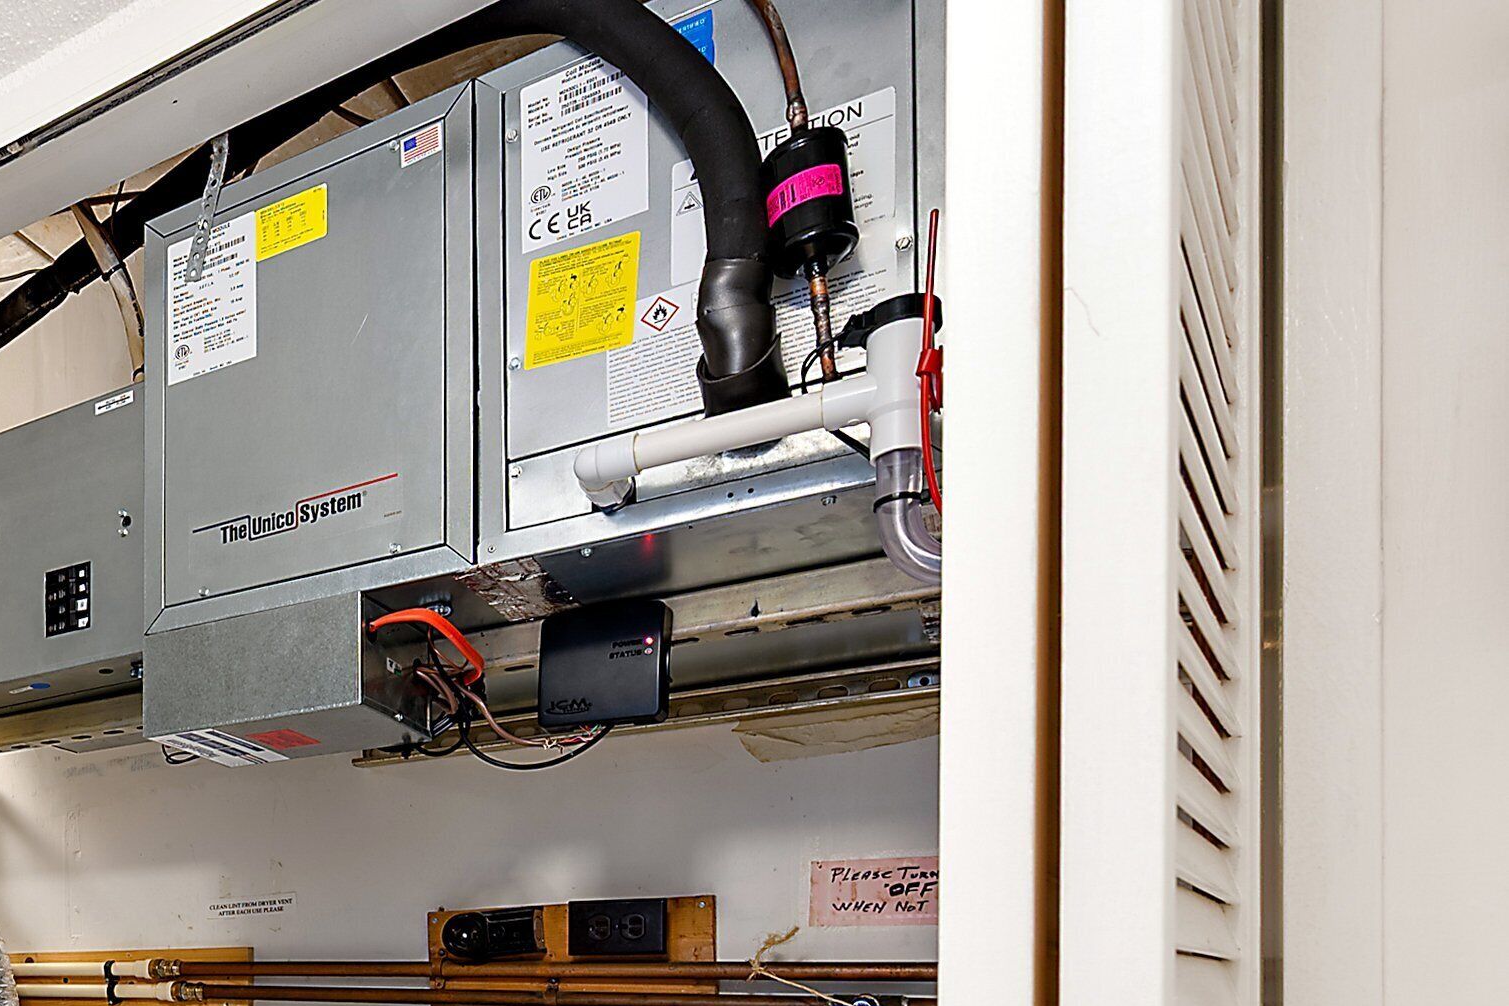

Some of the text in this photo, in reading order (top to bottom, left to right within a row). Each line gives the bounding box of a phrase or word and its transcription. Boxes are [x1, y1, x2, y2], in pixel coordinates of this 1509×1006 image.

[568, 201, 591, 218] UK
[529, 212, 560, 240] CE
[568, 214, 592, 230] CA
[221, 492, 362, 544] The Unico System
[609, 649, 642, 660] STATUS
[832, 900, 888, 914] WHEN
